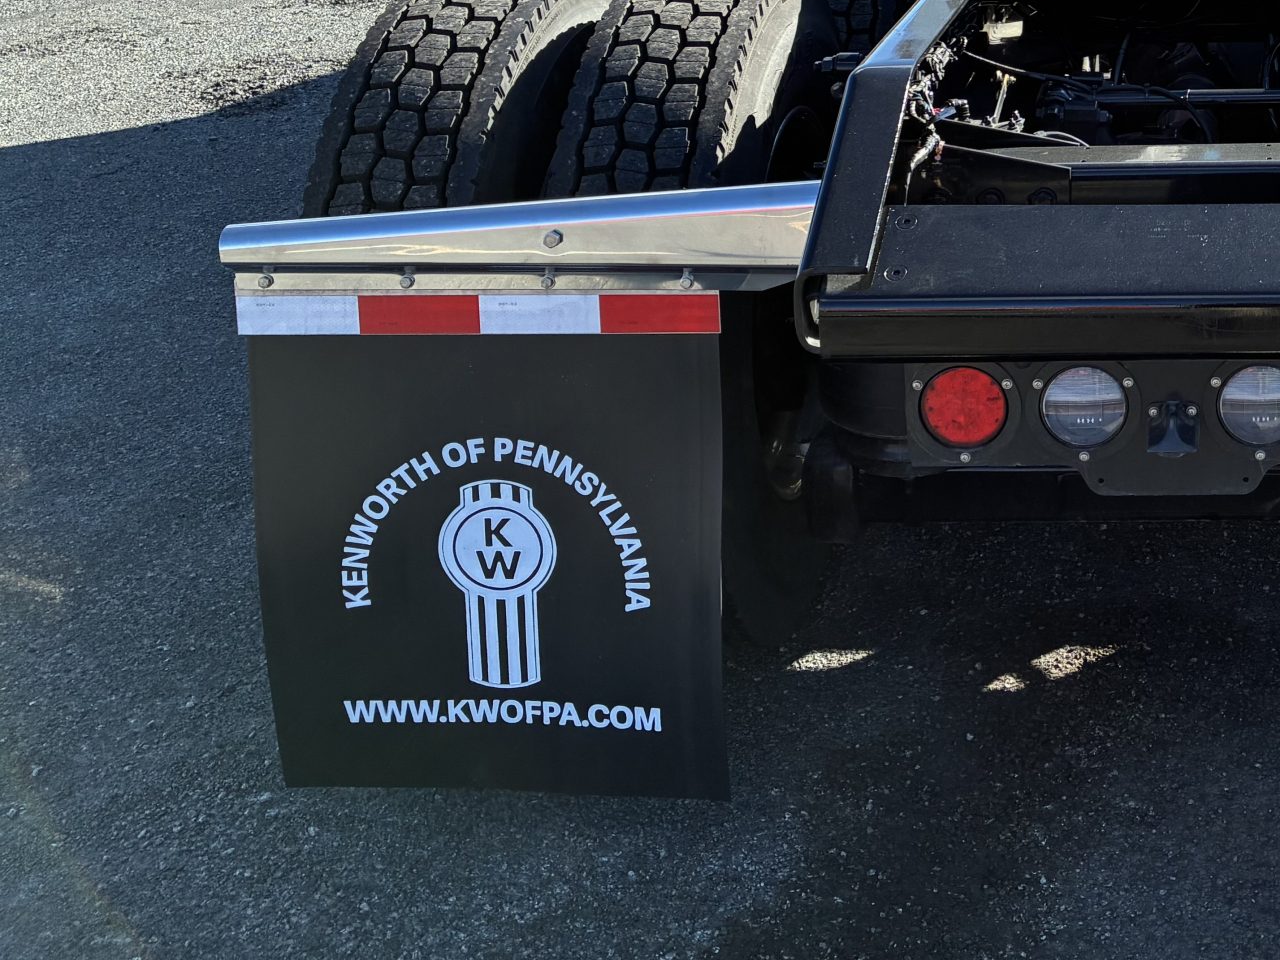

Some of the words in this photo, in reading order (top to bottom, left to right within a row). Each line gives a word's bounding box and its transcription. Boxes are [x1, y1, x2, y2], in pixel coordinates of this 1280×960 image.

[341, 451, 440, 609] KENWORTH
[441, 437, 486, 468] OF
[493, 437, 651, 612] PENNSYLVANIA
[483, 517, 513, 548] K
[475, 550, 522, 580] W
[342, 698, 663, 732] WWW.KWOFPA.COM
